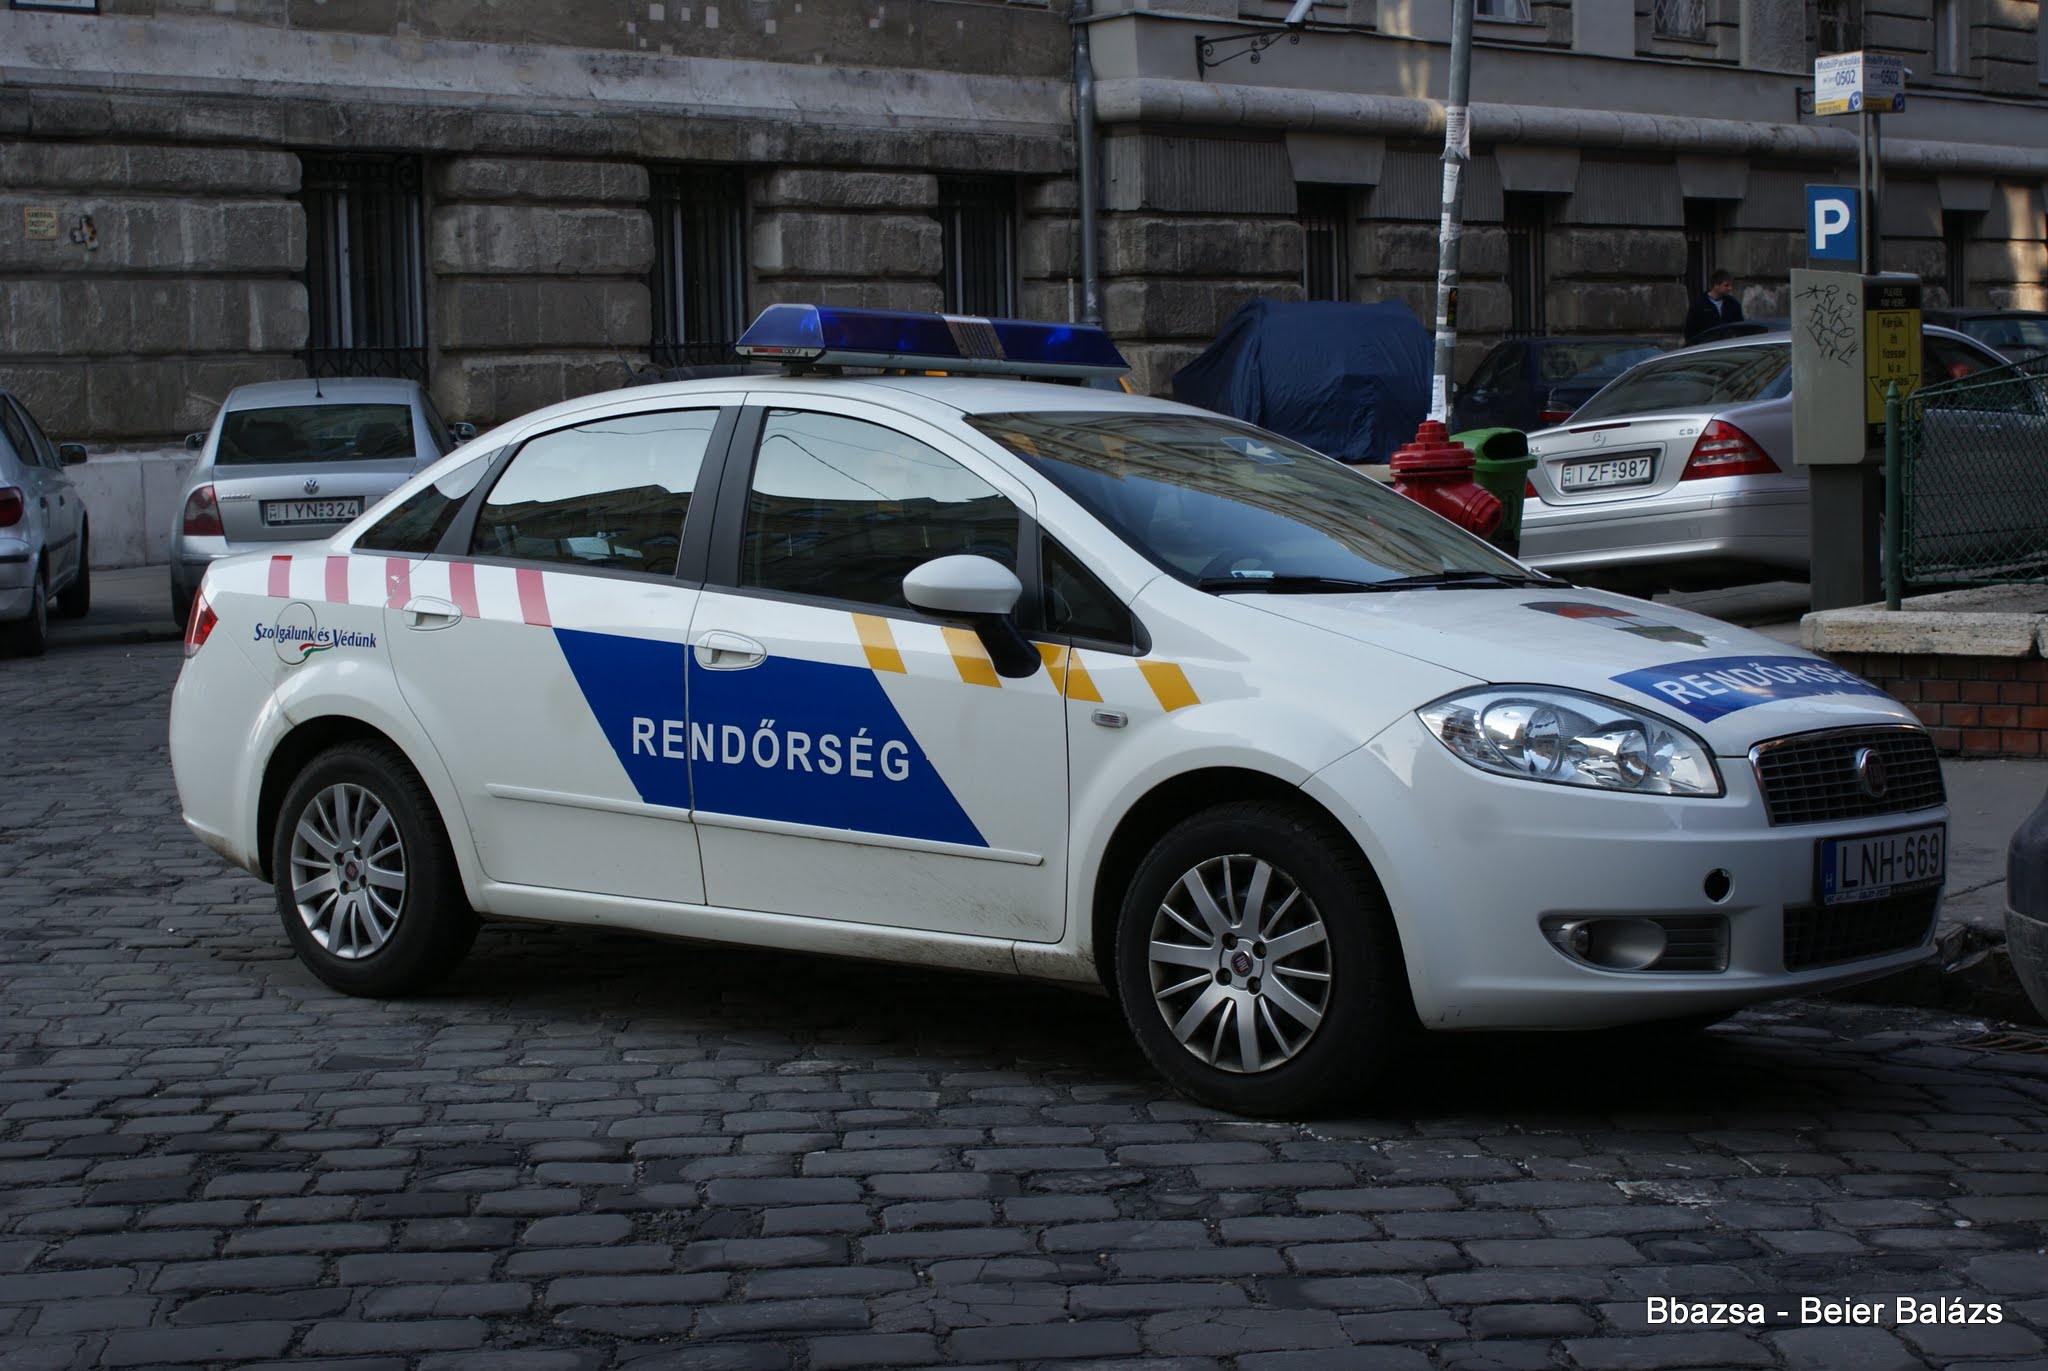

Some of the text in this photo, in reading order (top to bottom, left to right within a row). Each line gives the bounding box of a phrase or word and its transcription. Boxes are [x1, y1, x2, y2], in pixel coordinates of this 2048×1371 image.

[1835, 69, 1856, 86] 0502
[1881, 69, 1899, 85] 0502
[1814, 199, 1850, 250] P
[254, 623, 376, 648] Szolgálunk és Védünk
[632, 717, 909, 781] RENDŐRSÉG
[1825, 873, 1833, 889] H
[1842, 832, 1940, 888] LNH-669
